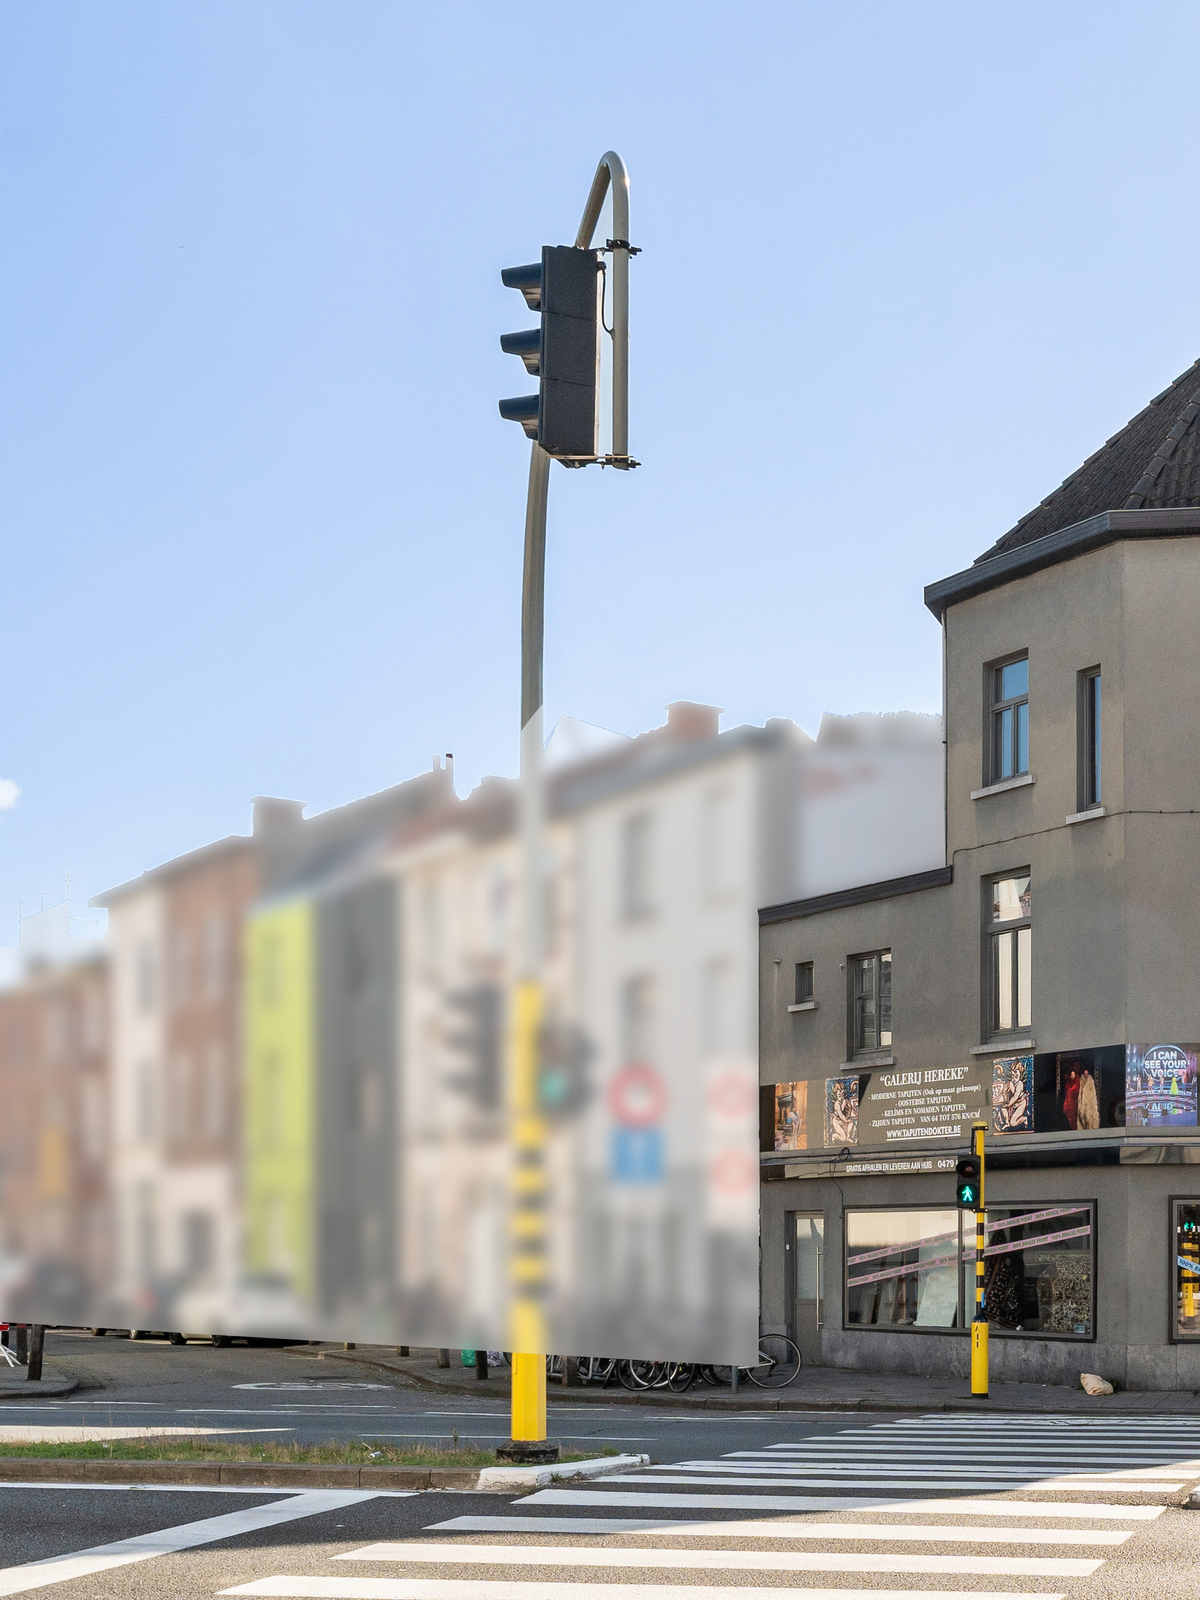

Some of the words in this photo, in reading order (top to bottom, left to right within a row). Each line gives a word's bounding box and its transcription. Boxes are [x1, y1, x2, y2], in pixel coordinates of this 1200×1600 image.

[1153, 1051, 1156, 1060] I
[1158, 1051, 1177, 1060] CAN
[1144, 1060, 1161, 1068] SEE
[1162, 1060, 1187, 1068] YOUR
[1151, 1069, 1178, 1077] VOICE
[886, 1125, 961, 1138] WWW.TAPIJTENDOKTER.BE
[862, 1163, 882, 1172] AFHALEN
[890, 1162, 910, 1170] LEVEREN
[921, 1161, 932, 1169] HUIS
[937, 1160, 954, 1168] 0479
[1179, 1258, 1194, 1269] 100%
